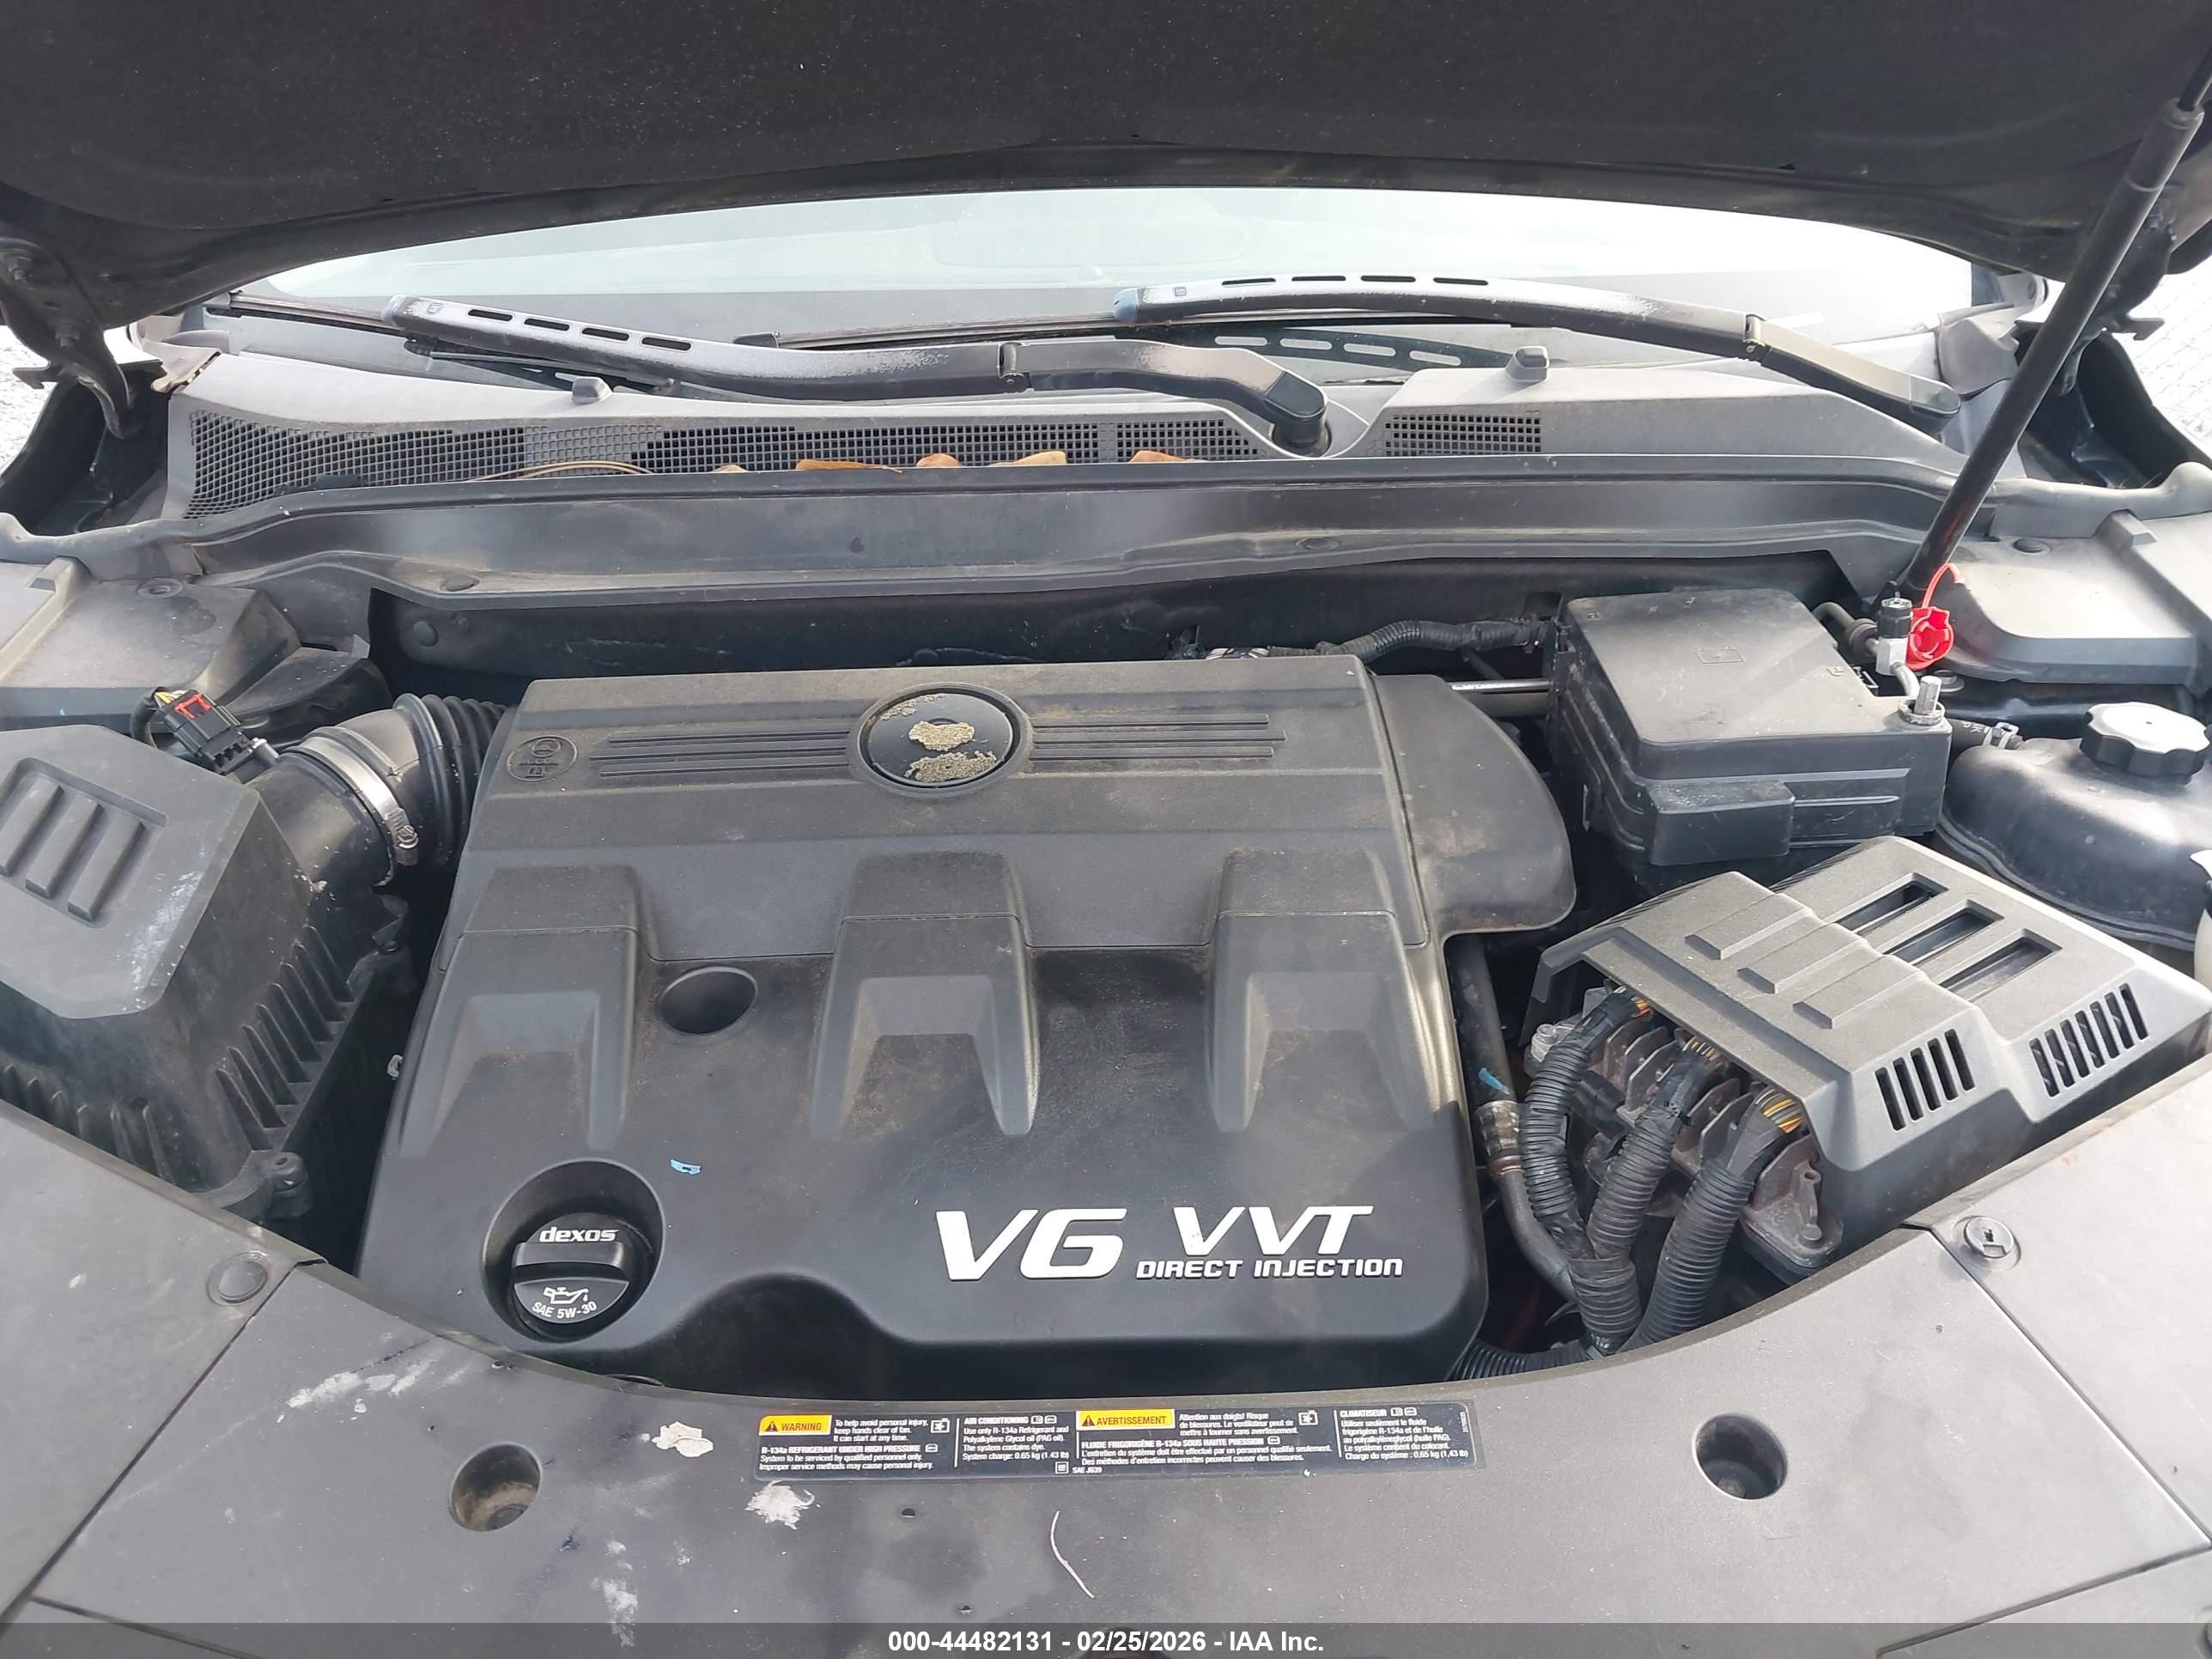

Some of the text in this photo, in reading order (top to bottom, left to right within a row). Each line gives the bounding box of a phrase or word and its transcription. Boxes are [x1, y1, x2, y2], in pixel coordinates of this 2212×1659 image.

[539, 1227, 619, 1243] dexos
[936, 1206, 1373, 1280] V6 VVT
[1136, 1258, 1403, 1279] DIRECT INJECTION
[532, 1302, 597, 1318] SAE 5W-30
